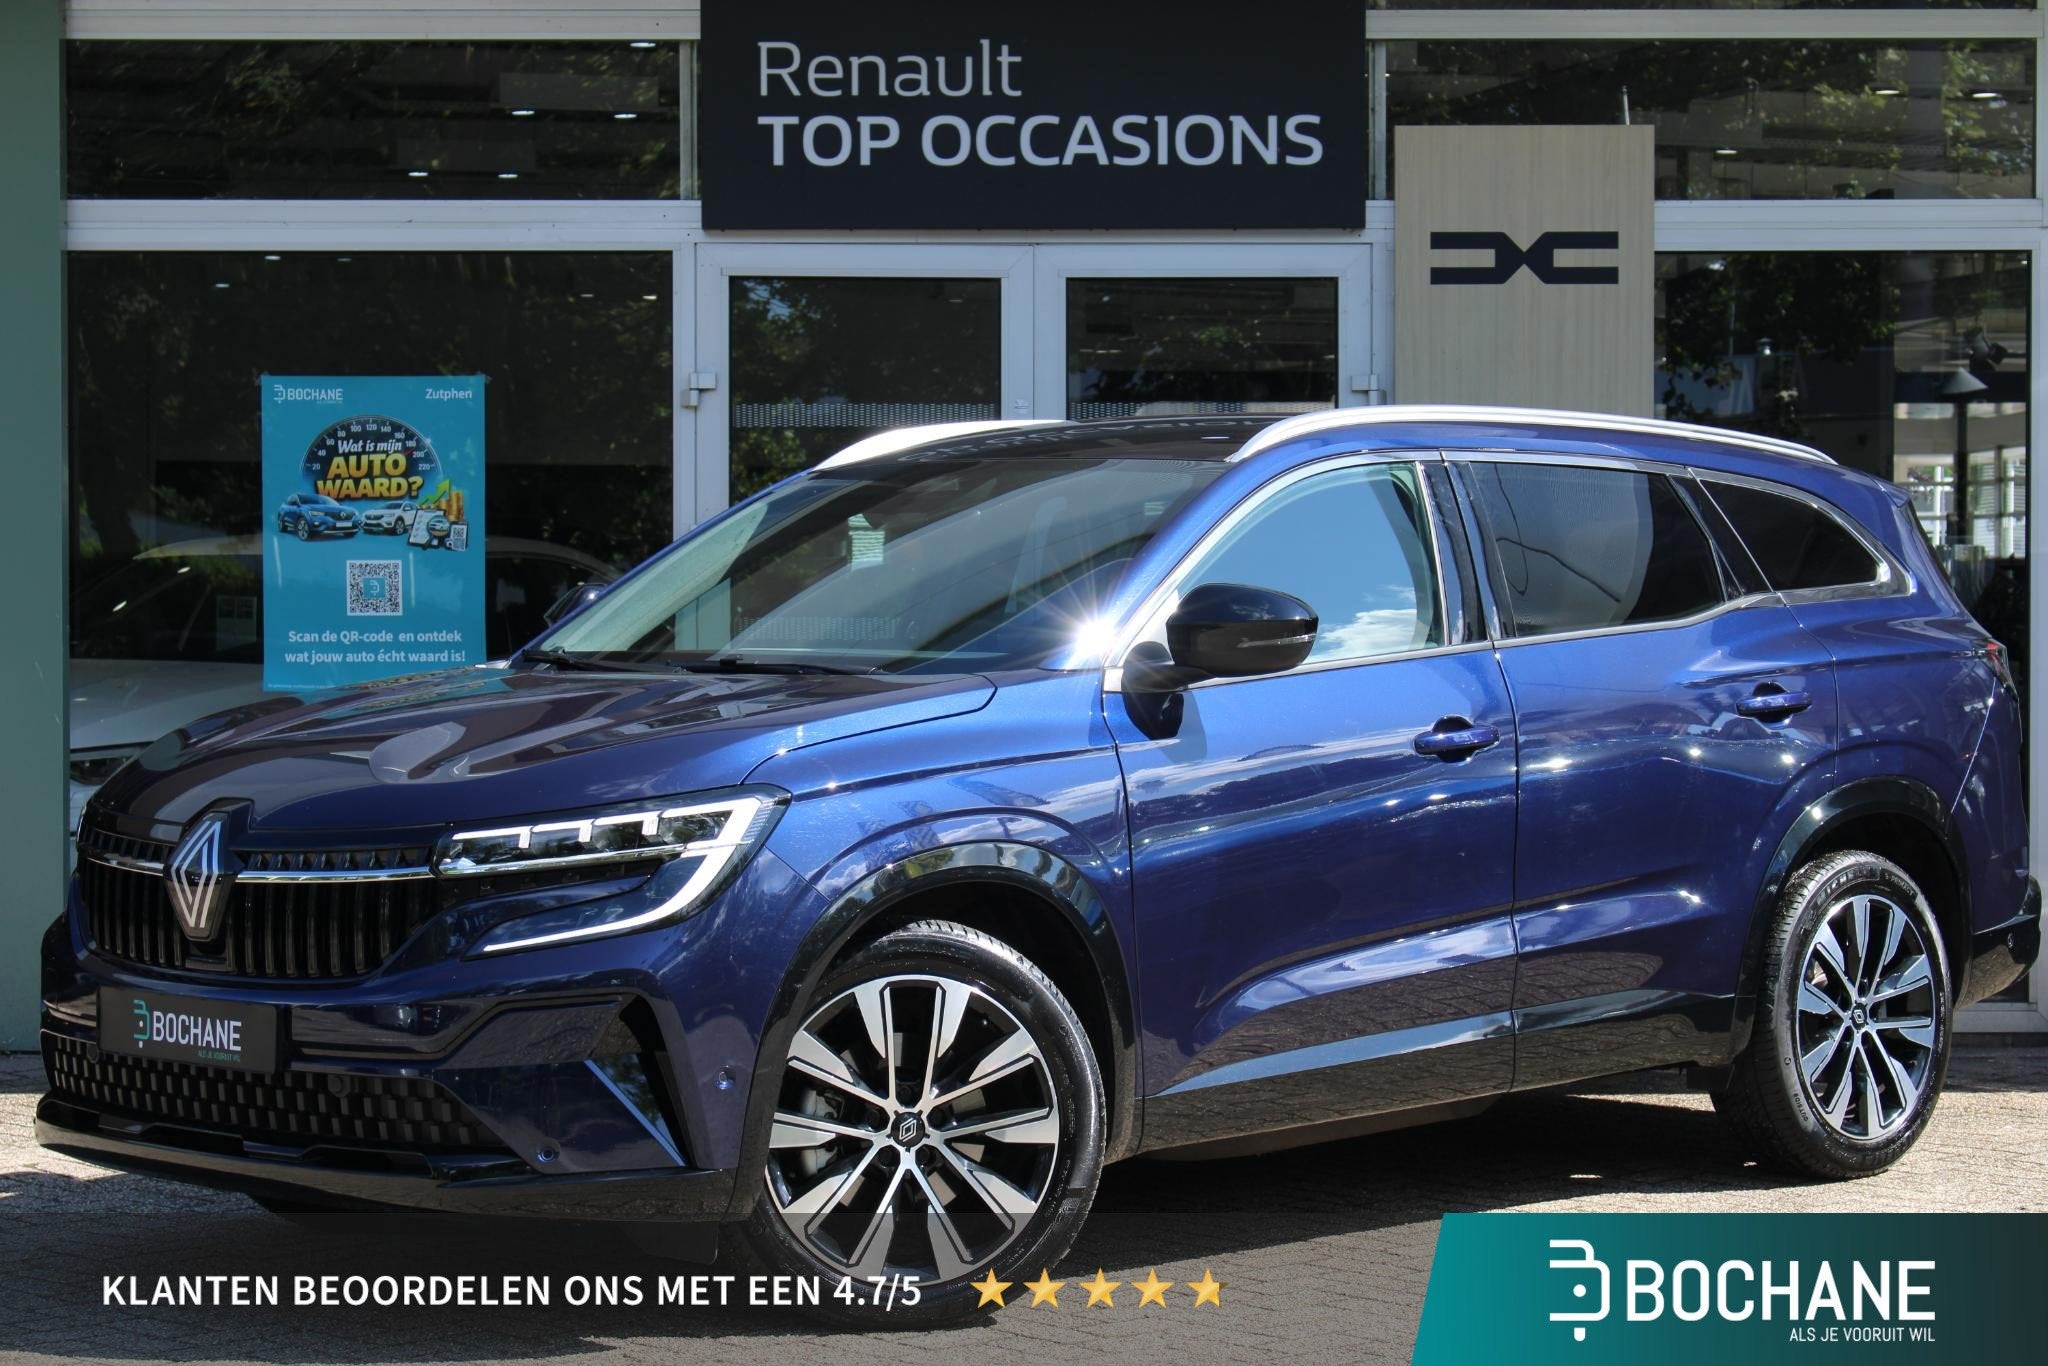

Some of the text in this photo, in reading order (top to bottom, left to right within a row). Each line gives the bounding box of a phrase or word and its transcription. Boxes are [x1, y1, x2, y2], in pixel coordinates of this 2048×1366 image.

[758, 39, 1021, 97] Renault
[758, 115, 1323, 166] TOP OCCASIONS
[287, 388, 343, 401] BOCHANE
[425, 388, 472, 402] Zutphen
[366, 423, 377, 431] 120
[338, 440, 402, 454] Wat is mijn
[412, 450, 424, 458] 200
[327, 454, 406, 479] AUTO
[317, 476, 423, 498] WAARD?
[288, 630, 462, 645] Scan de QR-code en ontdek
[285, 649, 466, 665] wat jouw auto écht waard is!
[153, 1011, 242, 1052] BOCHANE
